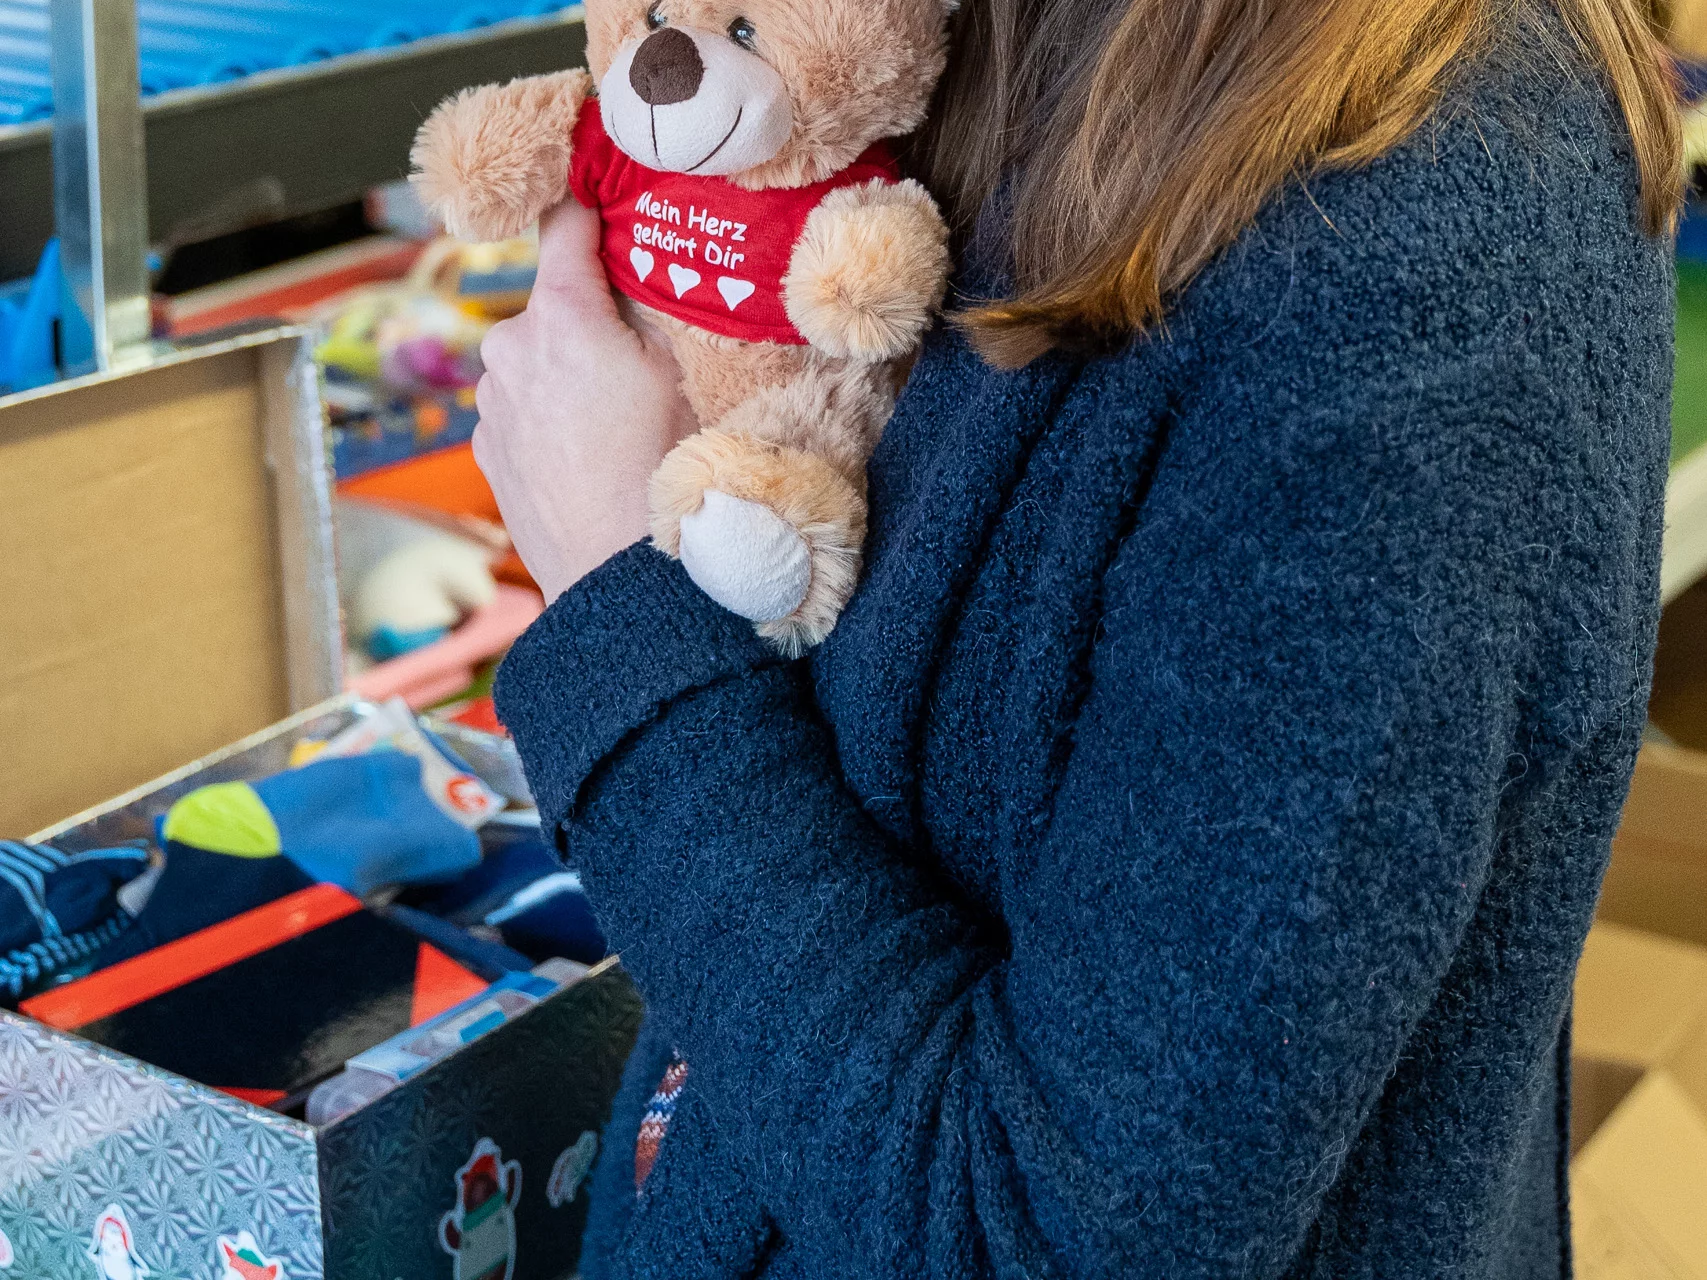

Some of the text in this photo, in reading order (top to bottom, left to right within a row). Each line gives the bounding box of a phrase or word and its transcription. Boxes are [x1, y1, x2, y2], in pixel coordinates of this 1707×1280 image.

[634, 191, 748, 242] Mein Herz
[633, 222, 745, 270] gehört Dir
